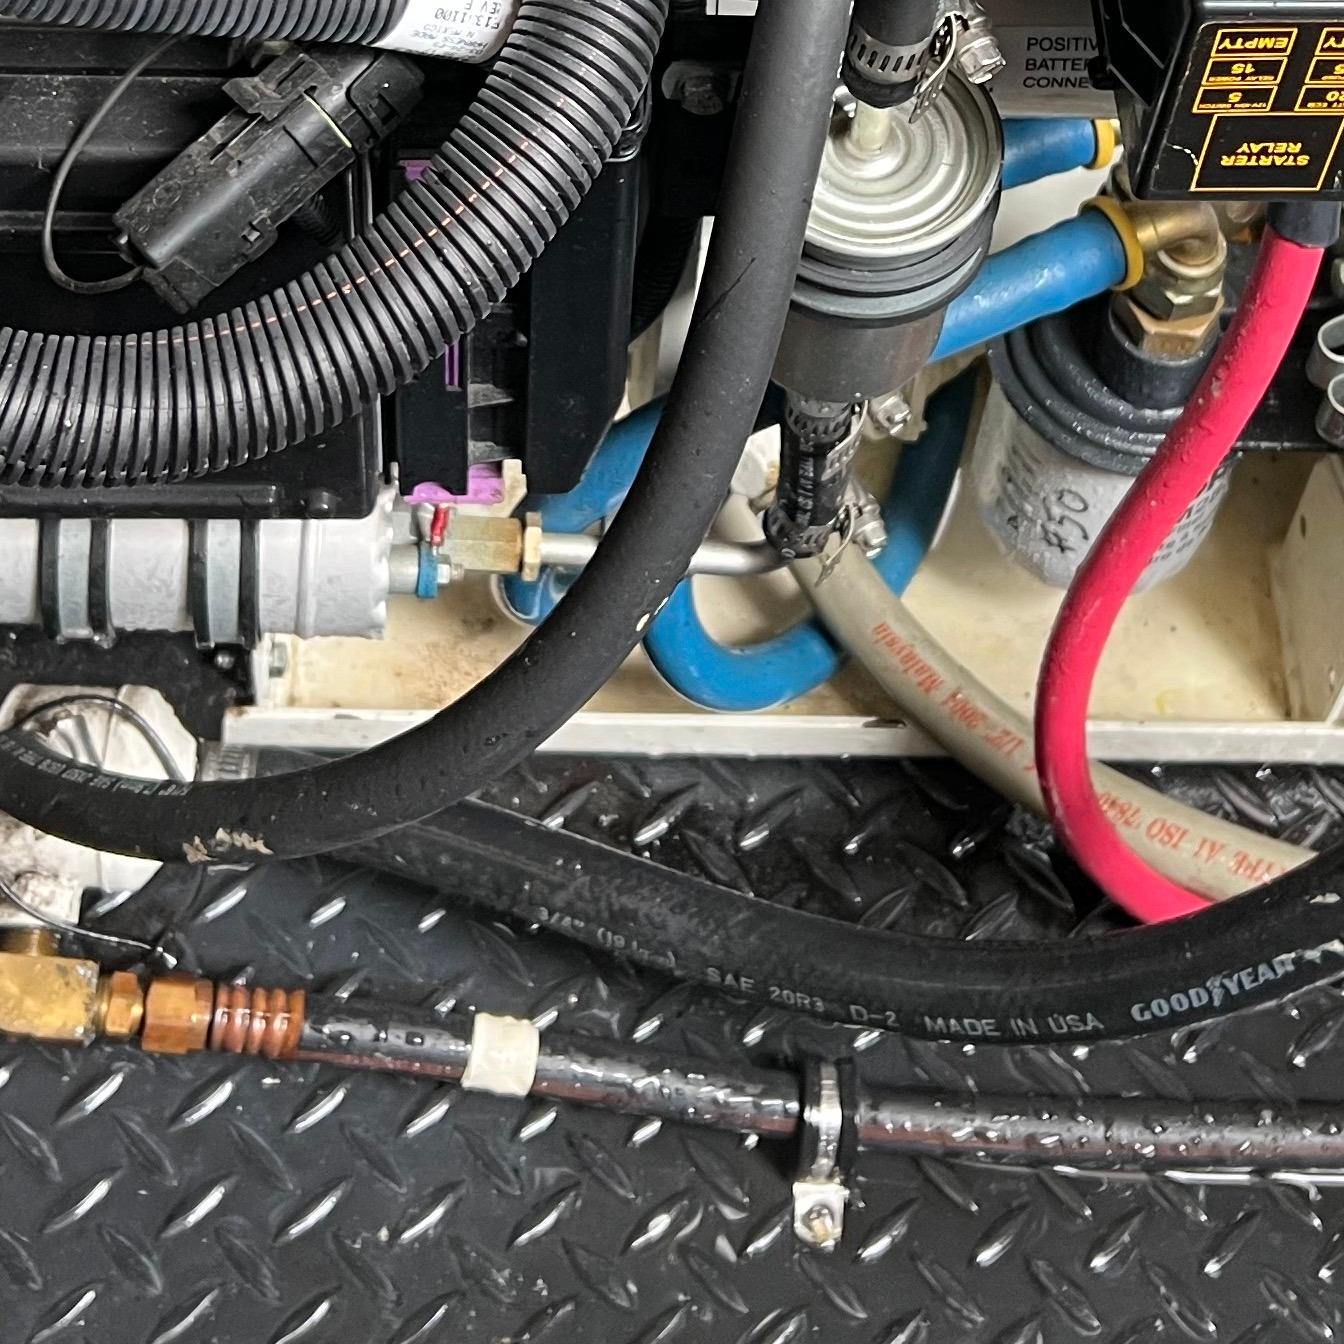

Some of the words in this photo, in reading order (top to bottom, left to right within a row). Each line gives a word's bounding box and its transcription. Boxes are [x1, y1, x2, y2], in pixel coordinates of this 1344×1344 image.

[1026, 37, 1099, 52] POSITIV
[1218, 37, 1289, 50] EMPTY
[1025, 58, 1090, 71] BATTE
[1231, 63, 1256, 75] 15
[1023, 76, 1089, 88] CONNE
[1228, 92, 1243, 103] 5
[1235, 142, 1302, 154] RELAY
[1220, 155, 1310, 167] STARTER
[1150, 817, 1191, 850] ISO
[706, 967, 754, 993] SAE
[767, 986, 825, 1013] 20R3
[849, 1004, 900, 1027] D-2
[923, 1014, 1002, 1037] MADE
[1010, 1015, 1039, 1037] IN
[1048, 1011, 1105, 1035] USA
[1130, 952, 1297, 1024] GOODYEAR
